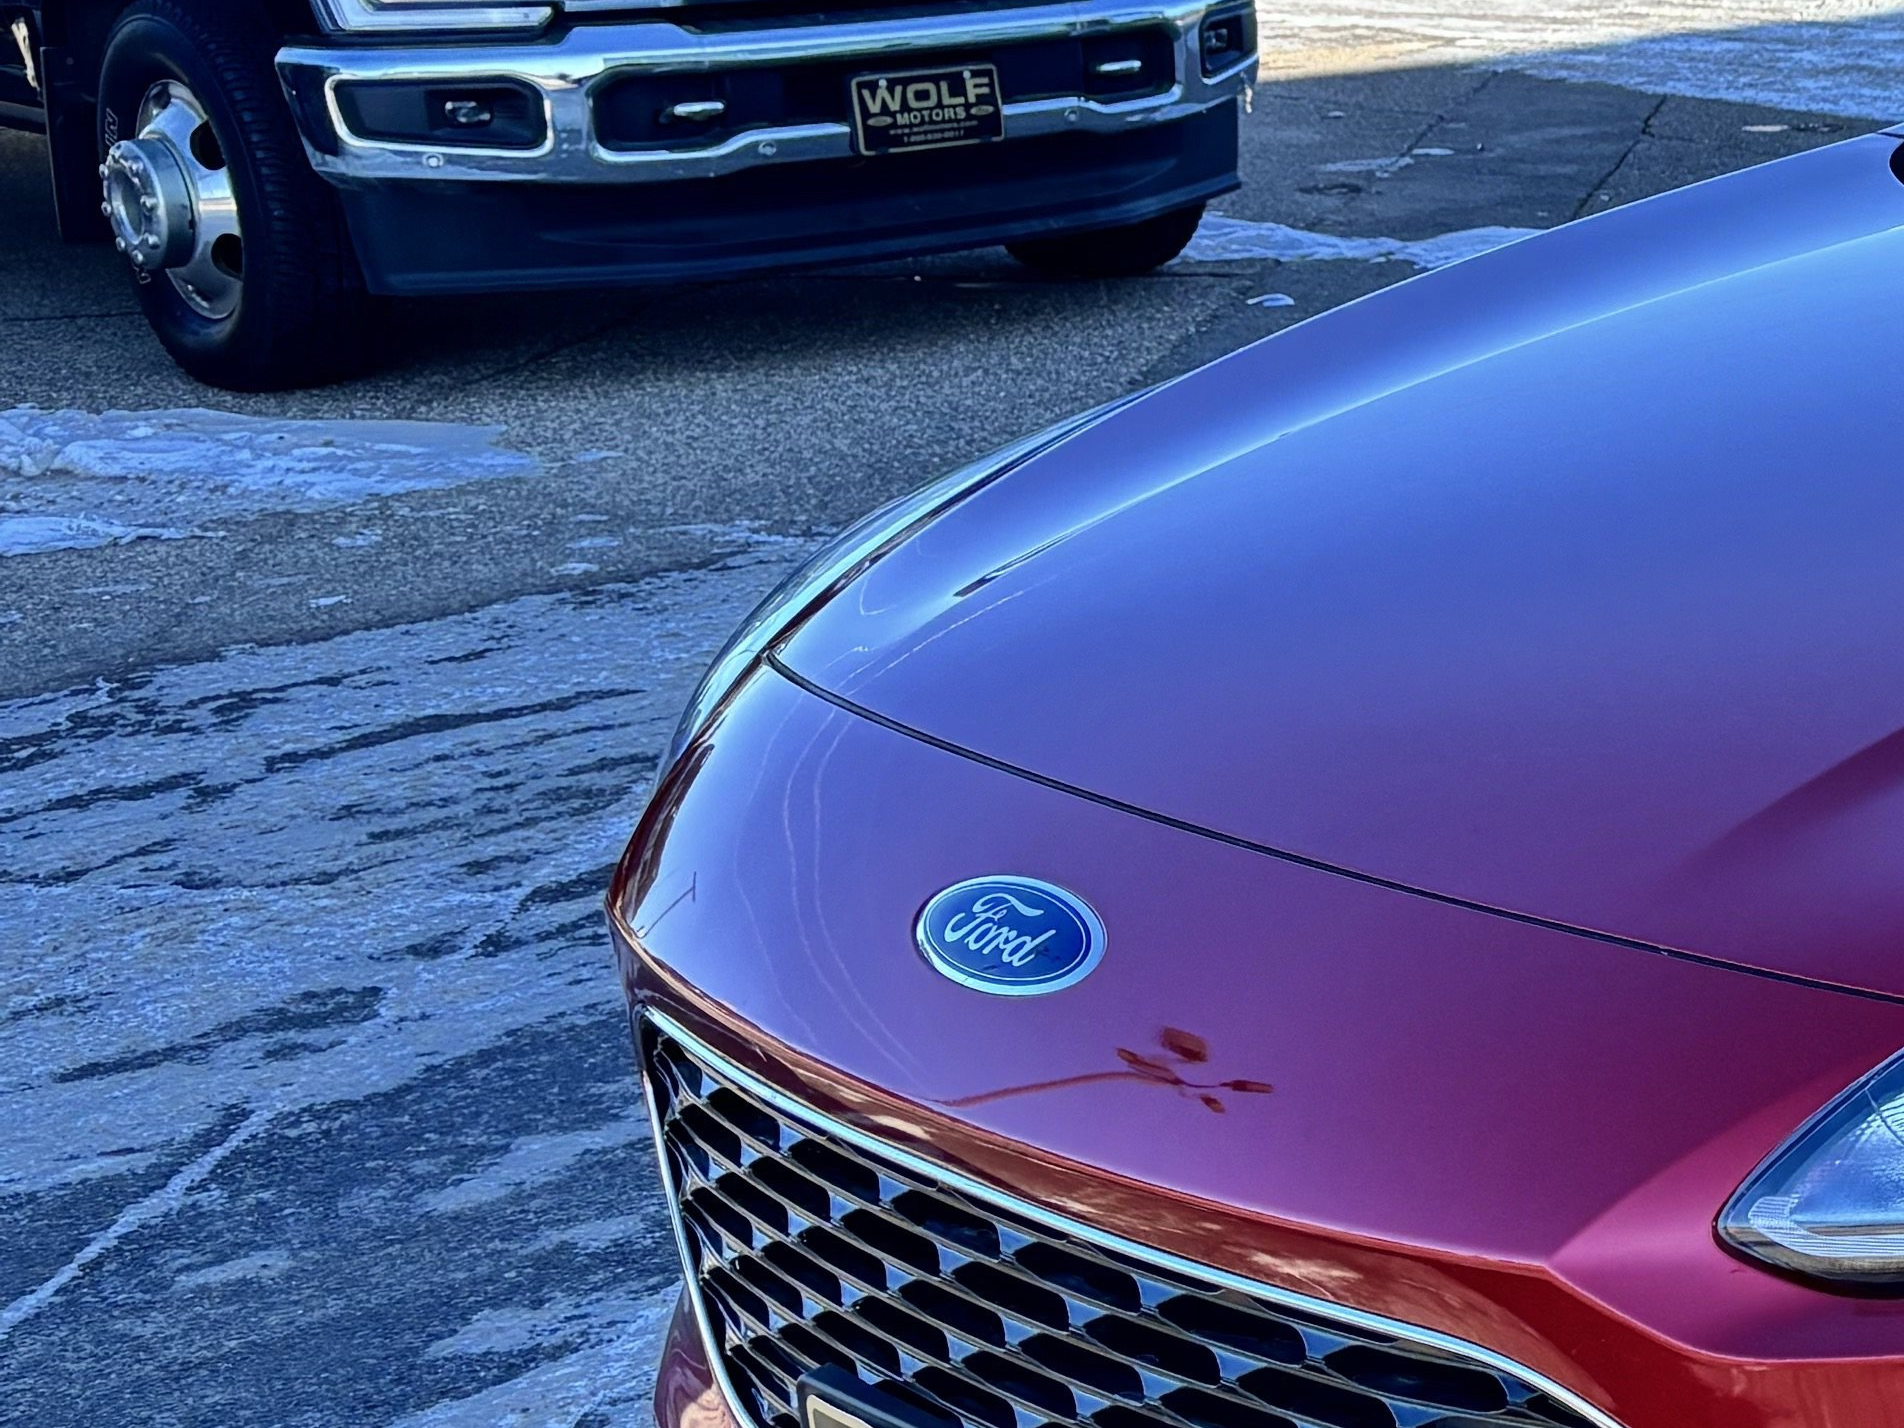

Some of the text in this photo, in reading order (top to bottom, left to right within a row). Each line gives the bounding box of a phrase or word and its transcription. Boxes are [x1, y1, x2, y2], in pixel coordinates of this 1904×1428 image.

[861, 76, 990, 114] WOLF
[896, 106, 966, 126] MOTORS
[944, 892, 1056, 967] Ford
